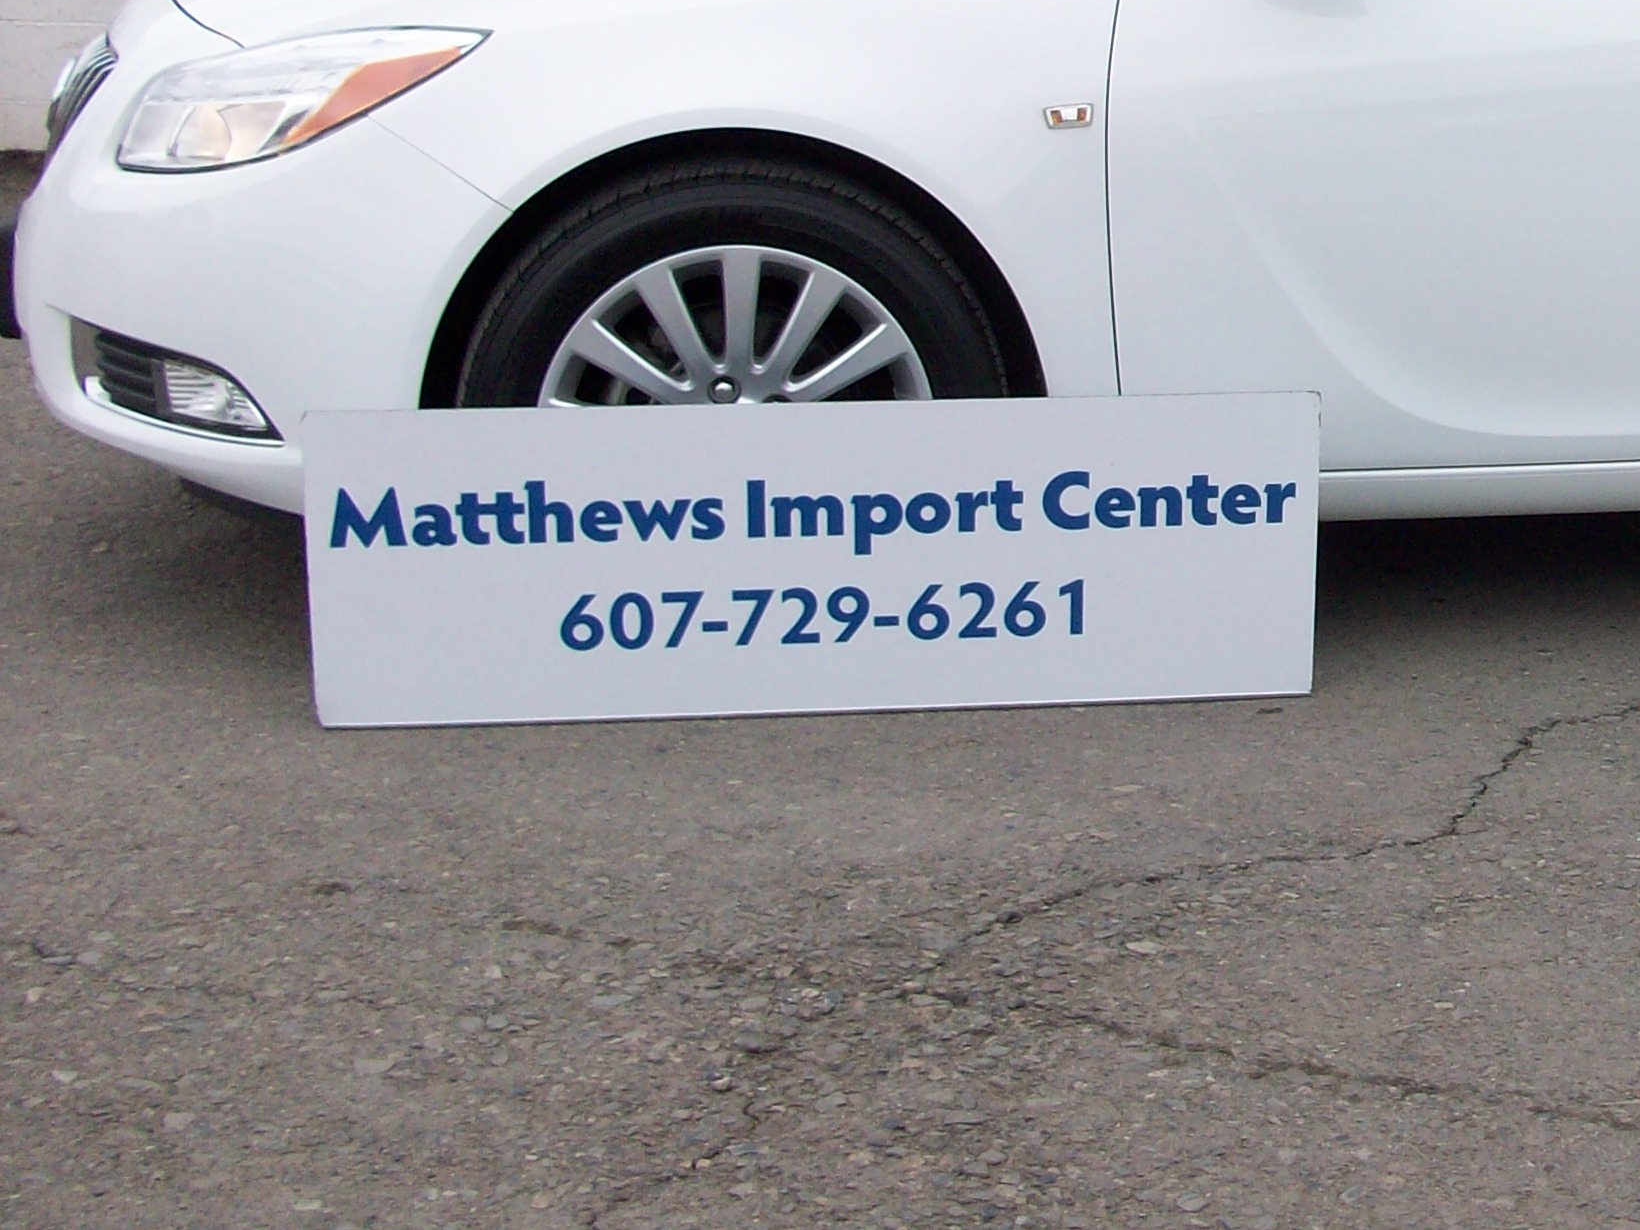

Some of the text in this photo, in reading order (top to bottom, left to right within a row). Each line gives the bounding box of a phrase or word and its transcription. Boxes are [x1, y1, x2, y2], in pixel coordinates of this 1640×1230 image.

[329, 470, 1297, 556] Matthews Import Center
[559, 578, 1084, 652] 607-729-6261
